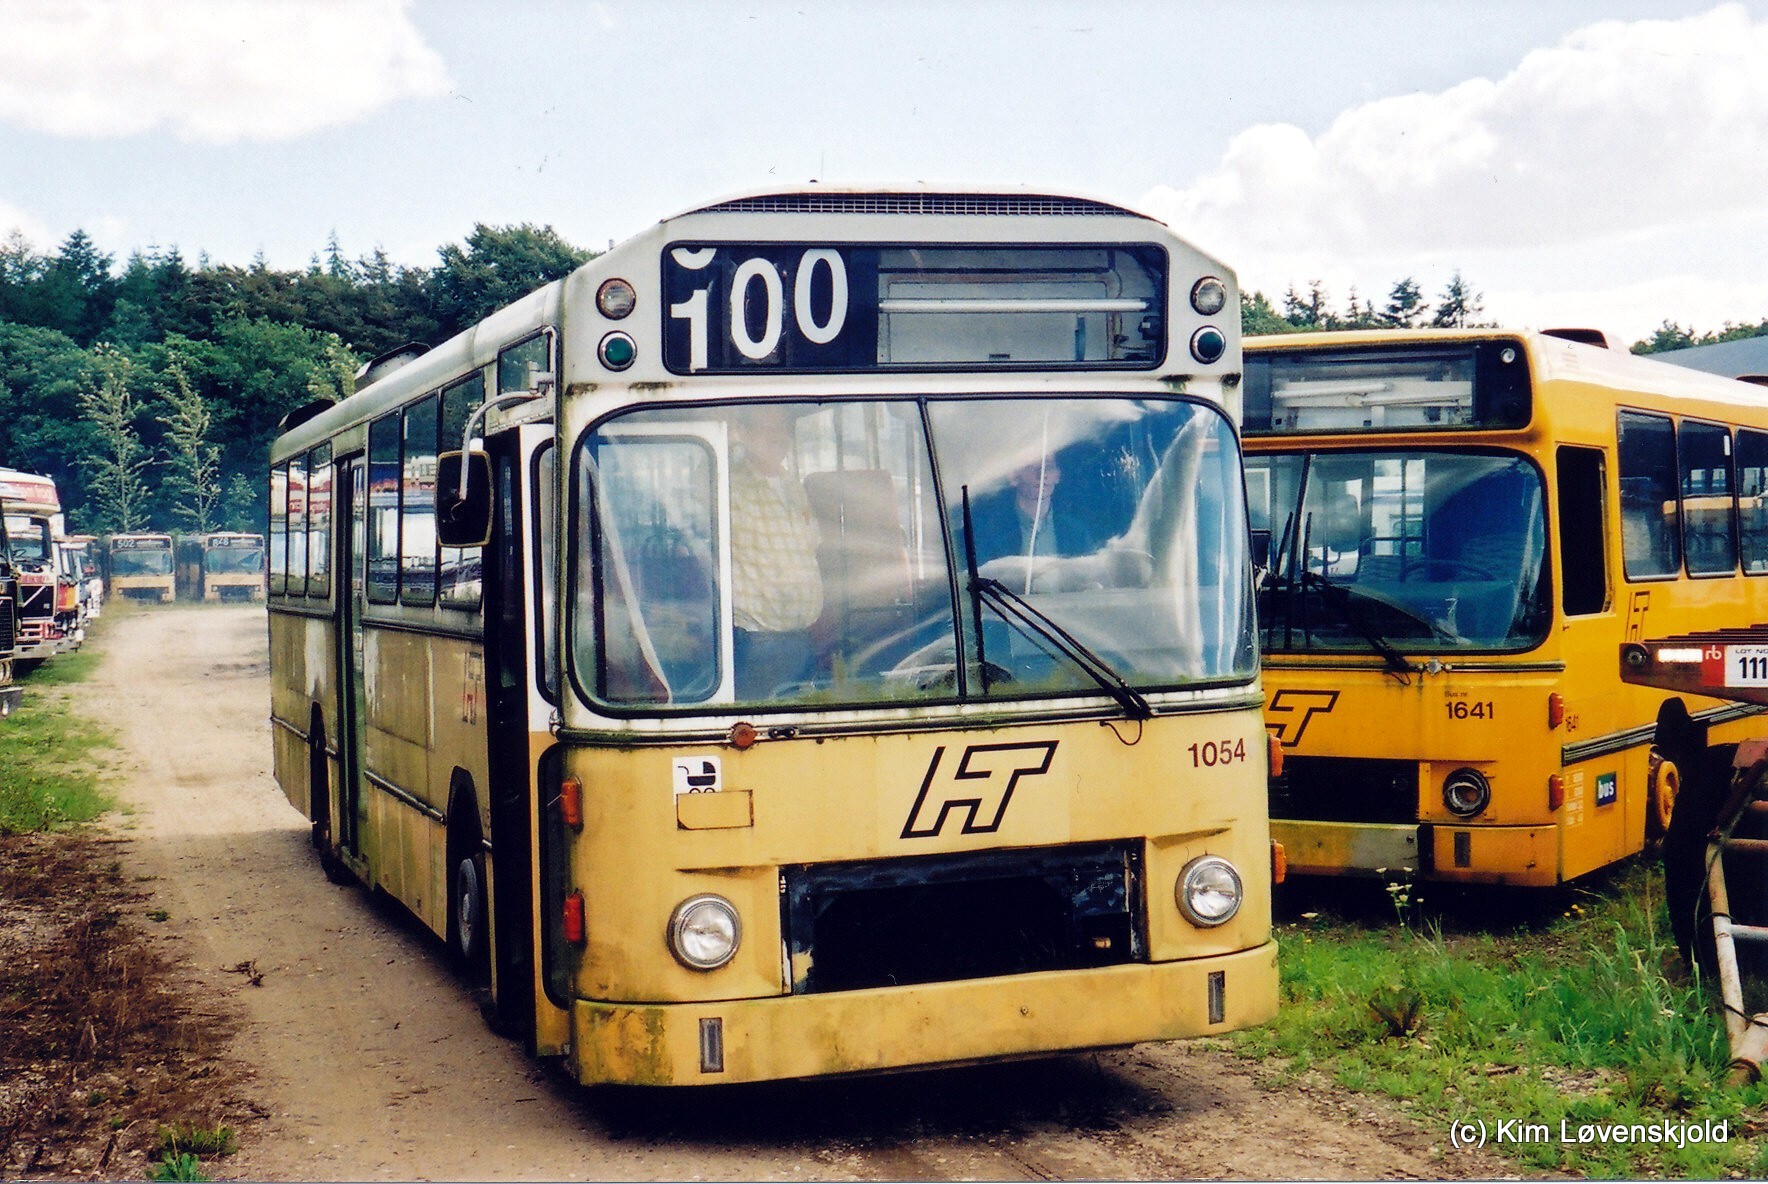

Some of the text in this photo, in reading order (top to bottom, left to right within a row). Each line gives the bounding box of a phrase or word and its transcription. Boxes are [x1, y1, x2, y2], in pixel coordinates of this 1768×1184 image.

[671, 248, 848, 373] 100
[1705, 645, 1722, 660] rb
[1738, 656, 1767, 679] 111
[1445, 701, 1493, 719] 1641
[1188, 737, 1246, 768] 1054
[900, 740, 1059, 839] HT
[1597, 780, 1614, 799] bus
